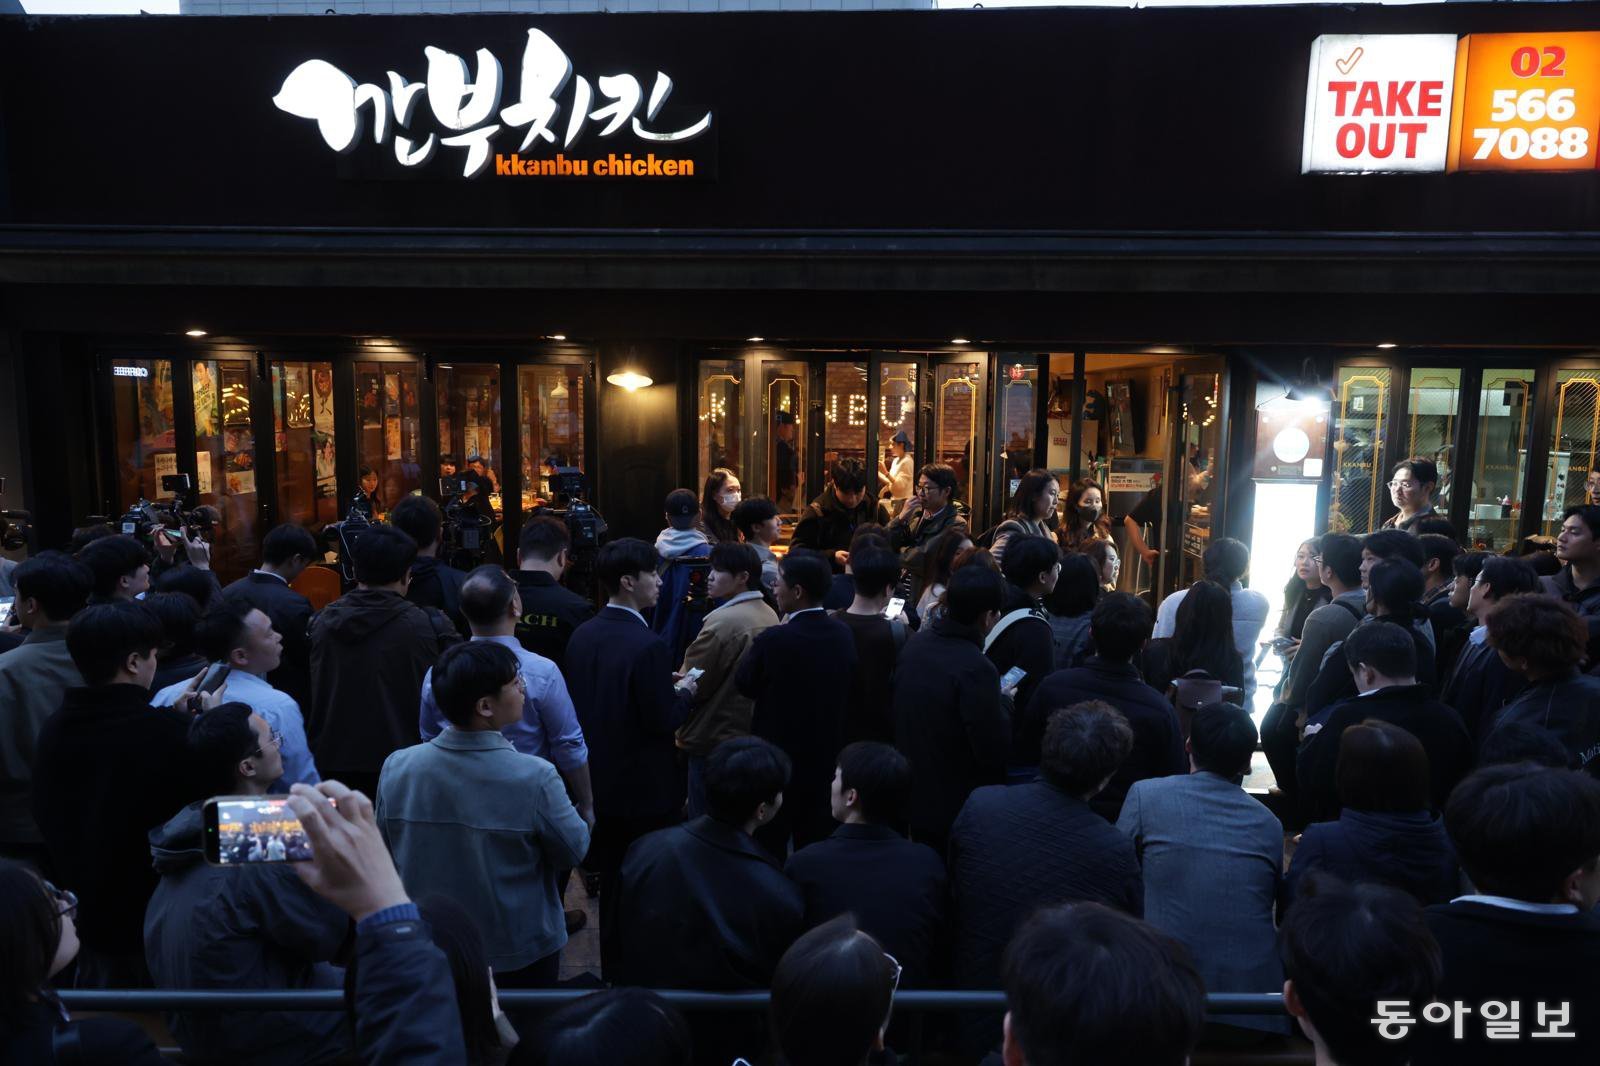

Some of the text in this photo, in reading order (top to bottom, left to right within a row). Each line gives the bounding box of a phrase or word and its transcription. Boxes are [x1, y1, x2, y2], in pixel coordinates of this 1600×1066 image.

[1510, 46, 1567, 78] 02
[272, 27, 712, 178] 깐부치킨
[1328, 81, 1444, 117] TAKE
[1491, 88, 1576, 122] 566
[1336, 123, 1428, 159] OUT
[1472, 127, 1589, 160] 7088
[496, 154, 694, 176] kkanbu chicken
[519, 614, 558, 627] CH
